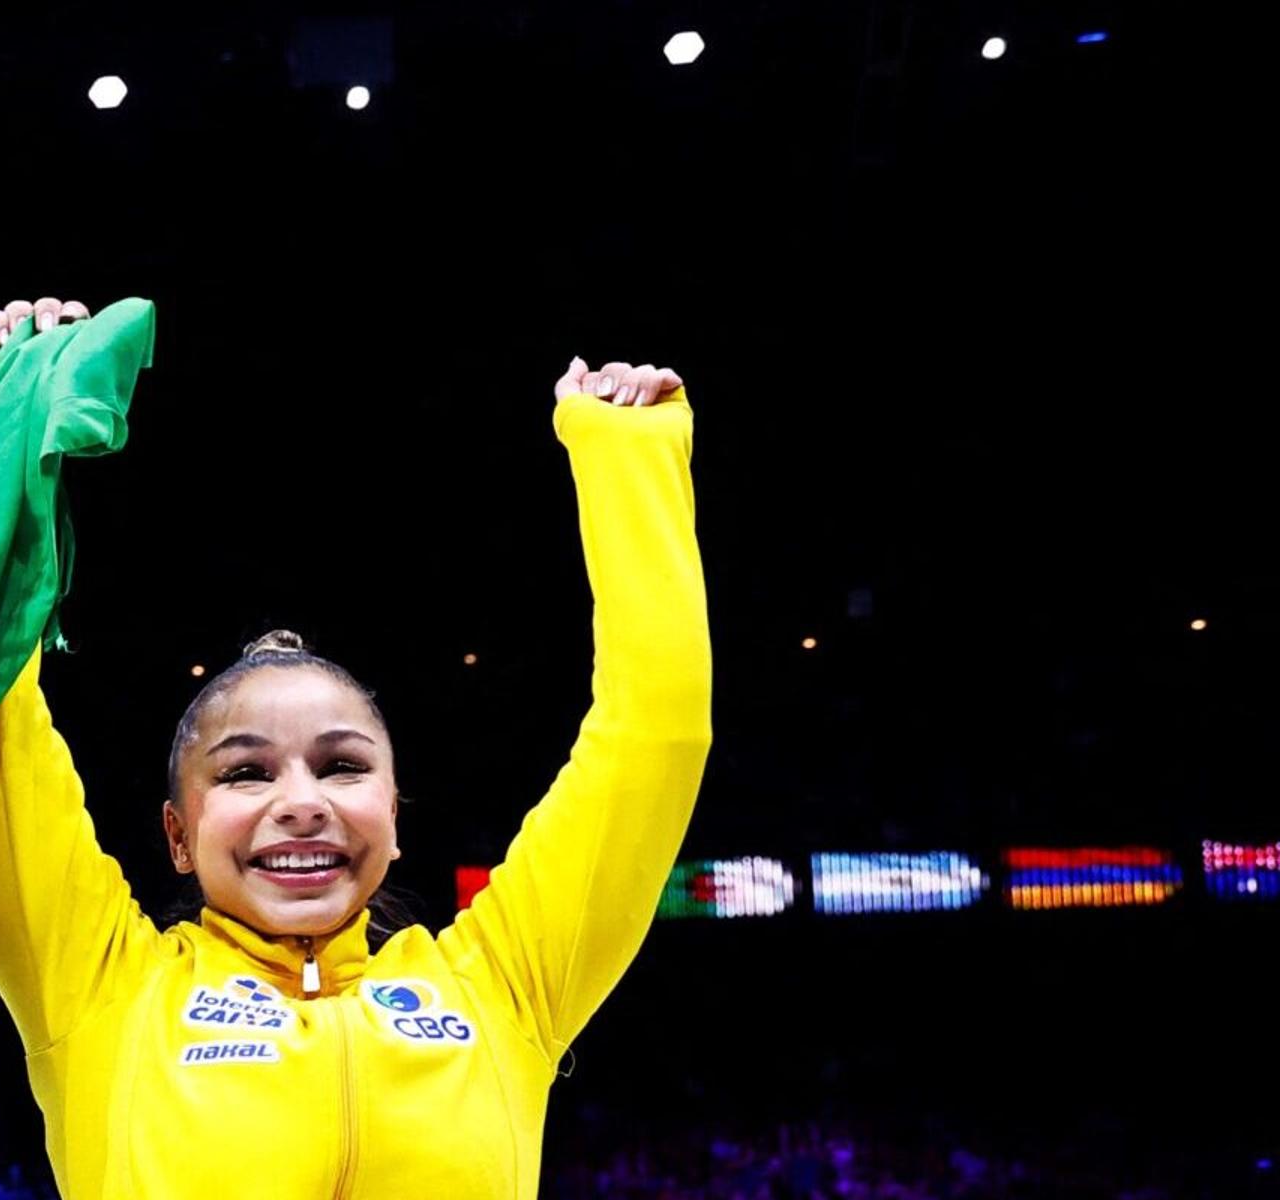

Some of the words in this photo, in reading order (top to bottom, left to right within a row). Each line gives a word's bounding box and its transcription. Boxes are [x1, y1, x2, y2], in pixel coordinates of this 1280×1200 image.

[195, 990, 288, 1018] loterias
[188, 1006, 282, 1029] CAIXA
[393, 1015, 470, 1041] CBG
